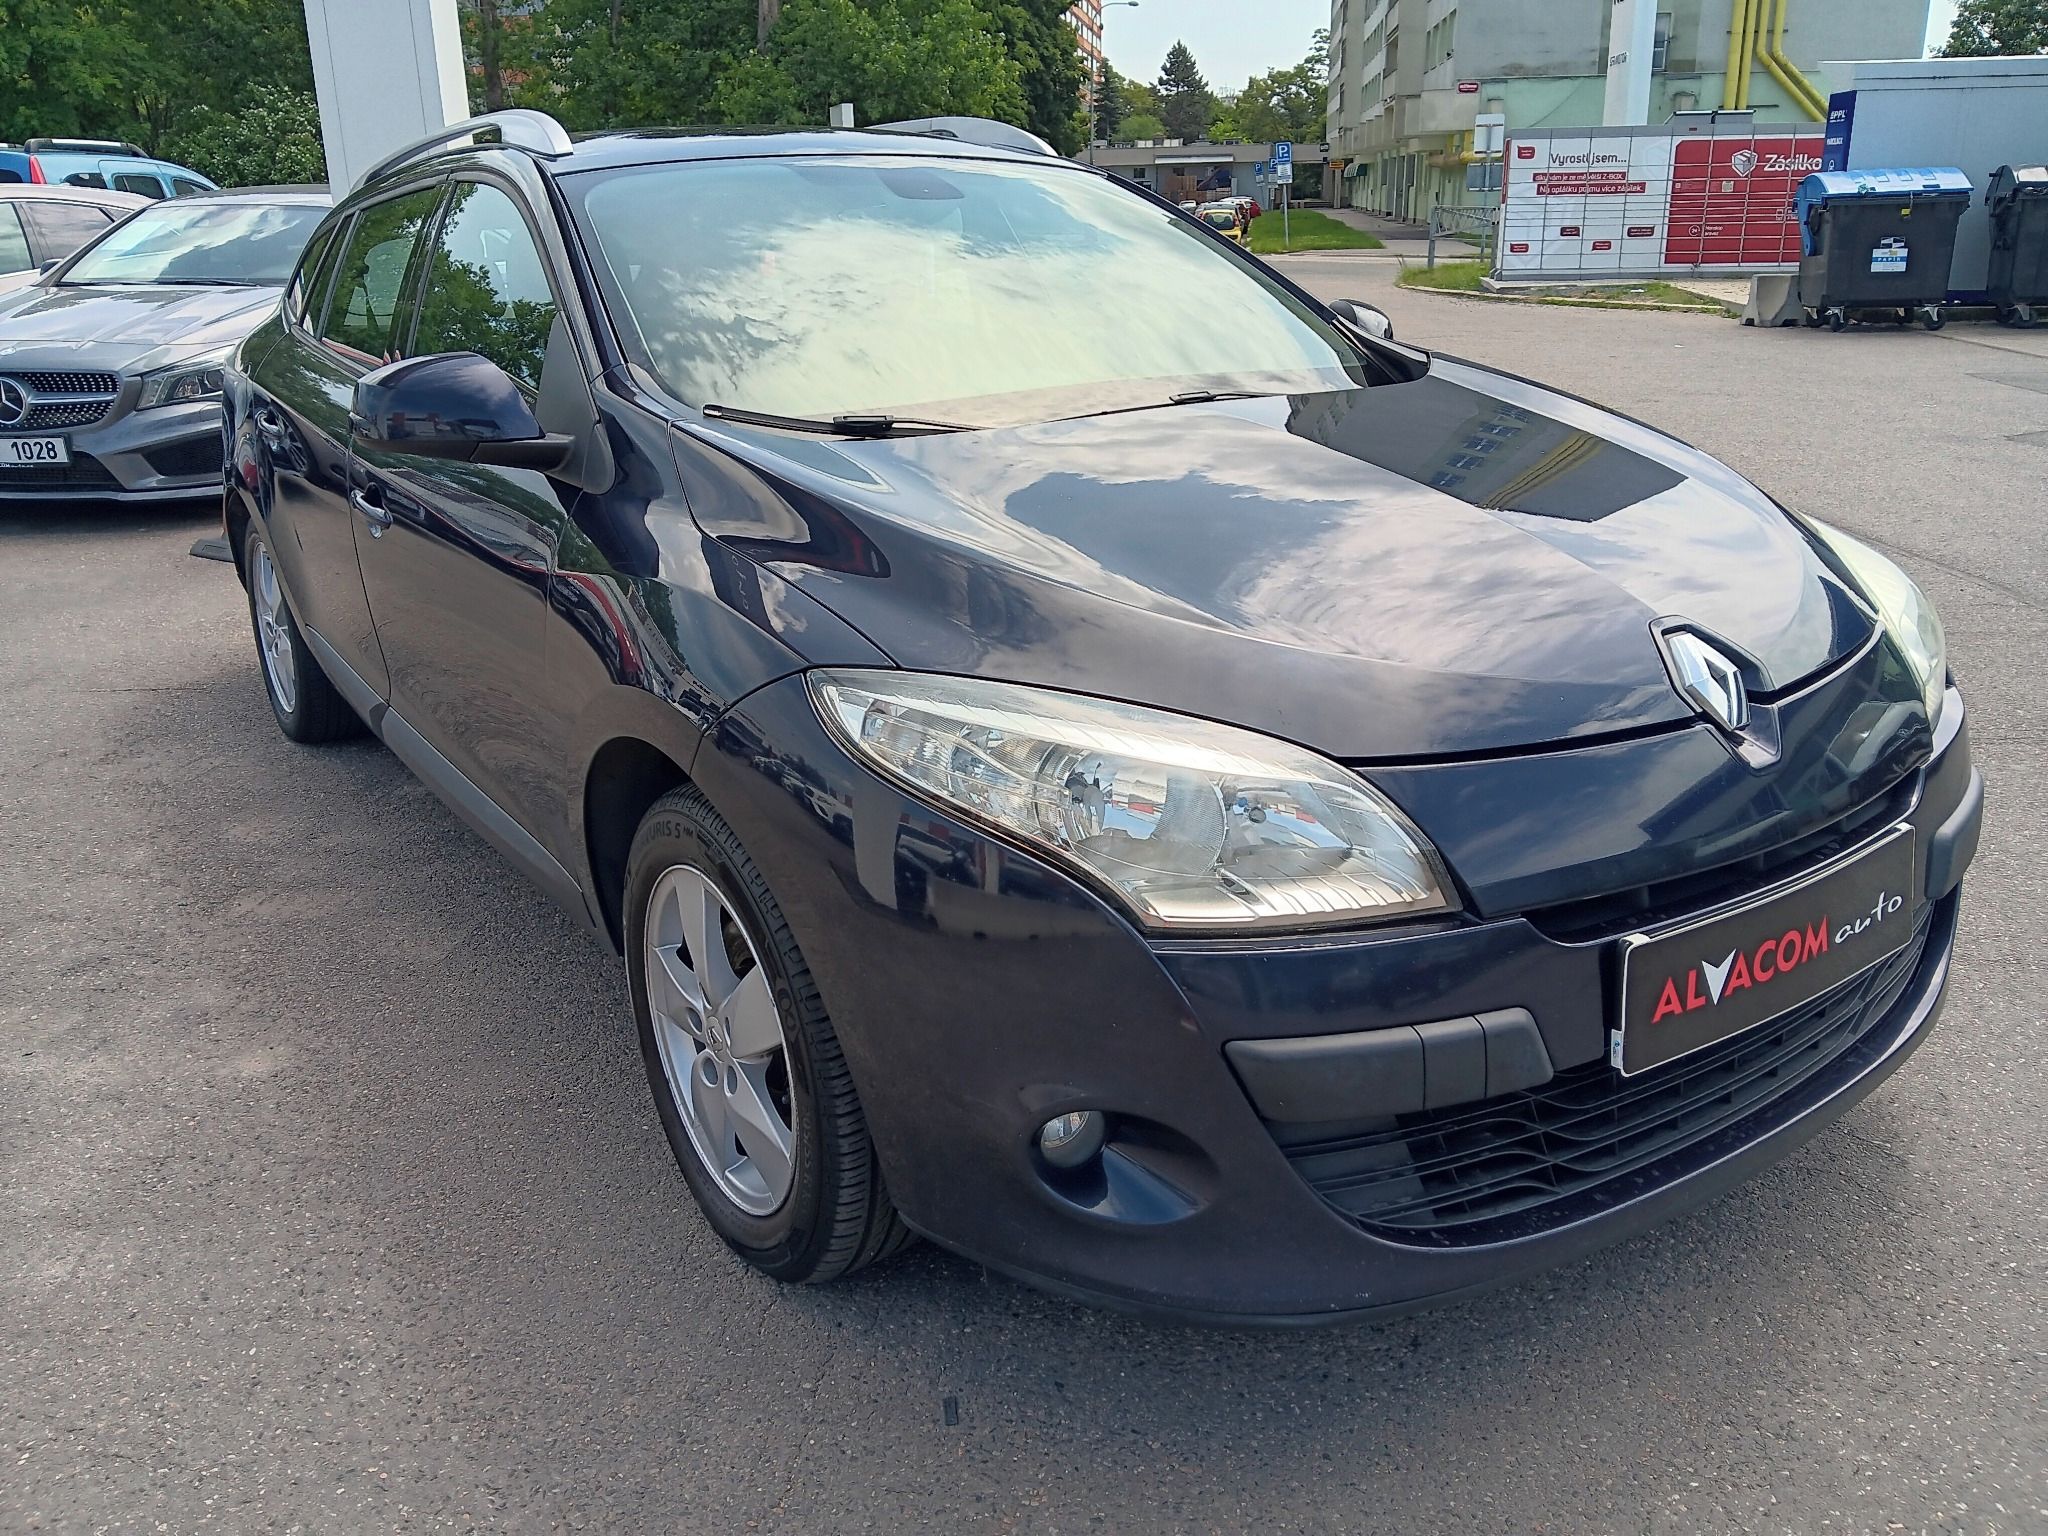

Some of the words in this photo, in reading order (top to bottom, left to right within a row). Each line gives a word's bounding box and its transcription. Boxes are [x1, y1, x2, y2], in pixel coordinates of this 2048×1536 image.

[1279, 145, 1288, 158] P
[1551, 153, 1590, 166] Vyrostl
[11, 441, 58, 460] 1028
[1651, 914, 1829, 1024] ALVACOM
[1835, 891, 1903, 944] auto
